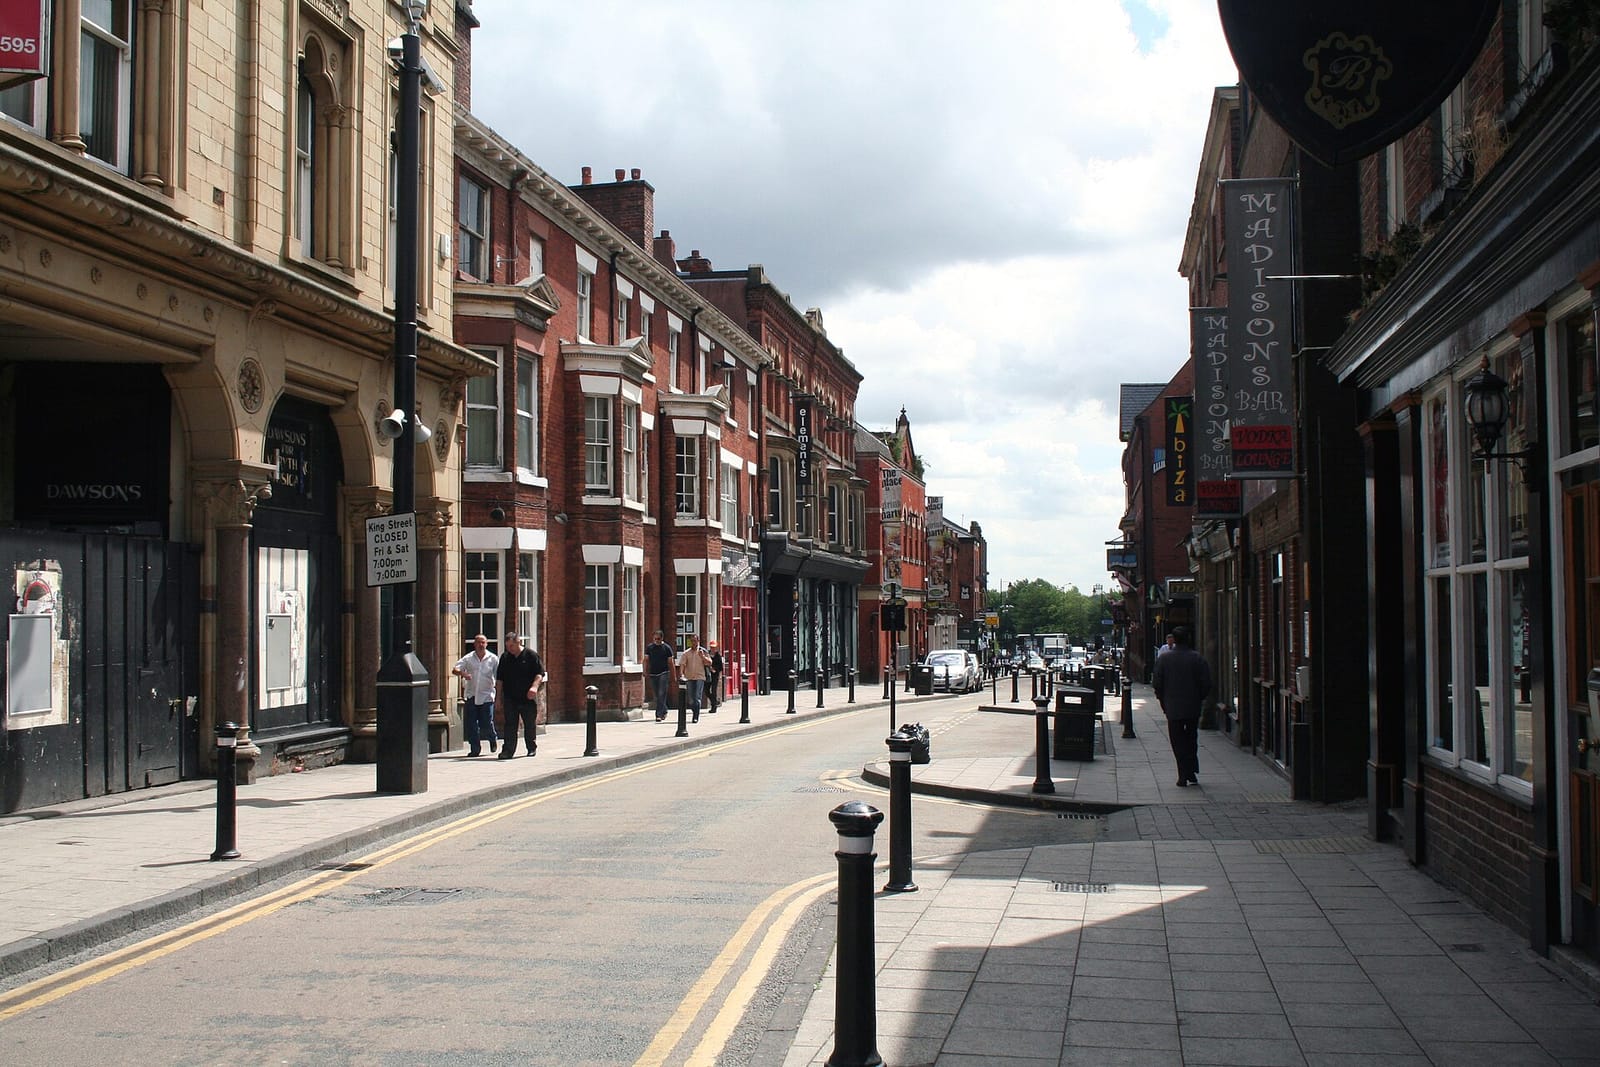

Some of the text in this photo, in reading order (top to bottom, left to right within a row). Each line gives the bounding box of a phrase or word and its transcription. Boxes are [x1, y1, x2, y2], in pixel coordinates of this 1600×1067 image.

[0, 36, 36, 54] 595
[1240, 193, 1279, 386] MADISONS
[1235, 390, 1288, 414] BAR
[798, 408, 808, 478] elements
[1236, 429, 1288, 445] VODKA
[1235, 453, 1291, 469] LOUNGE
[47, 484, 141, 501] DAWSONS
[368, 517, 412, 533] King Street
[374, 530, 408, 543] CLOSED
[374, 543, 409, 557] Fri & Sat
[373, 558, 403, 569] 7:00pm
[376, 569, 407, 581] 7:00am
